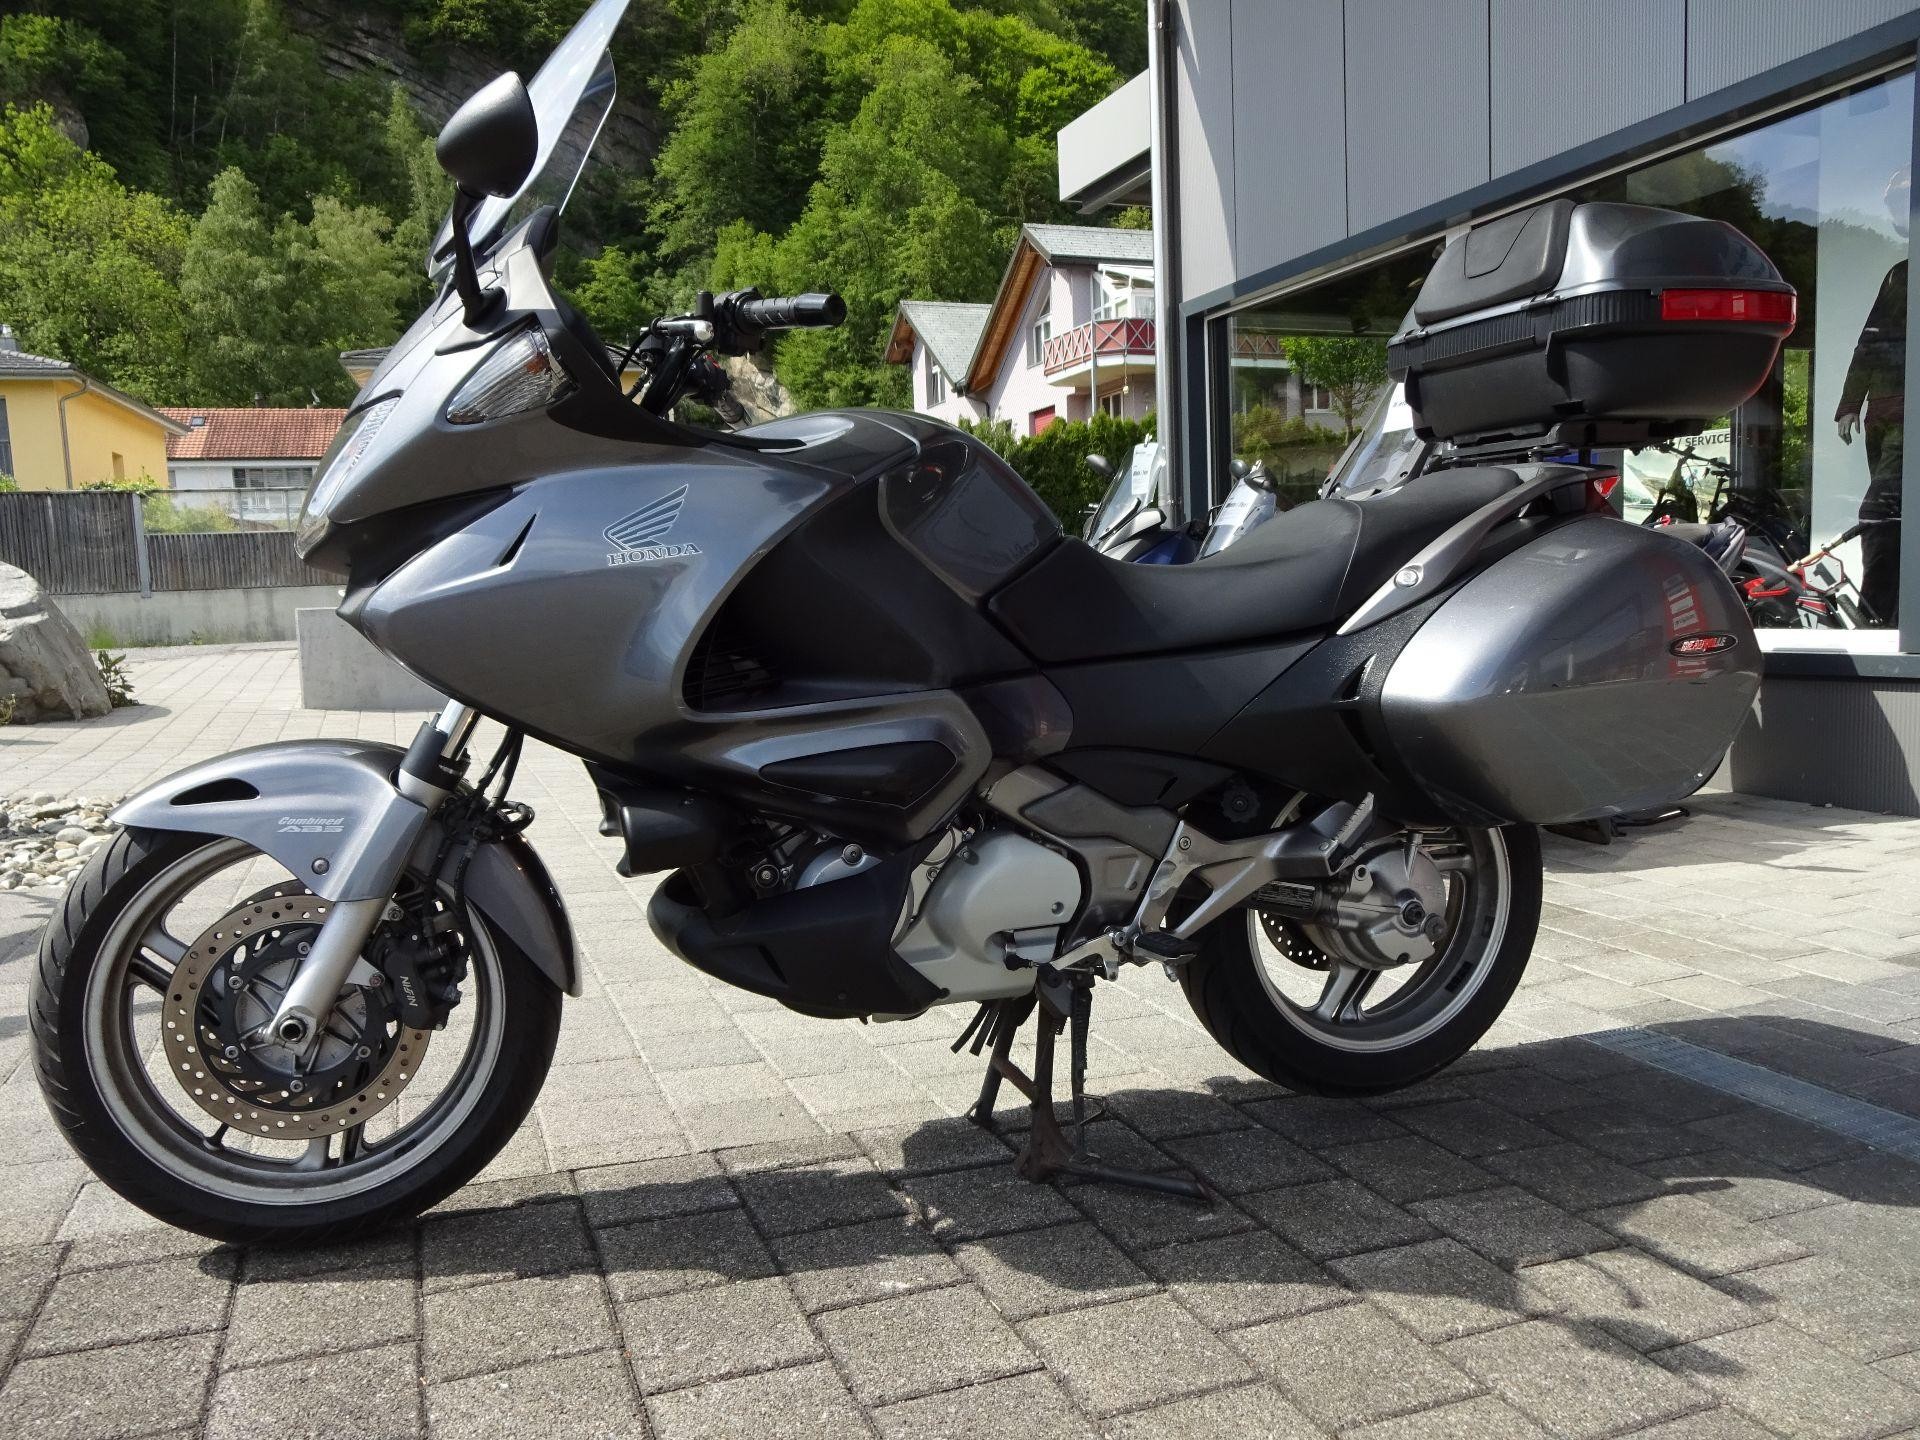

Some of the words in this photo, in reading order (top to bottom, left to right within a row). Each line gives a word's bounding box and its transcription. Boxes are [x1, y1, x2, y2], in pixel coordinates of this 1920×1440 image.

[1685, 434, 1730, 447] SERVICE
[607, 543, 702, 566] HONDA
[1813, 562, 1837, 586] 1
[278, 816, 344, 825] Combined
